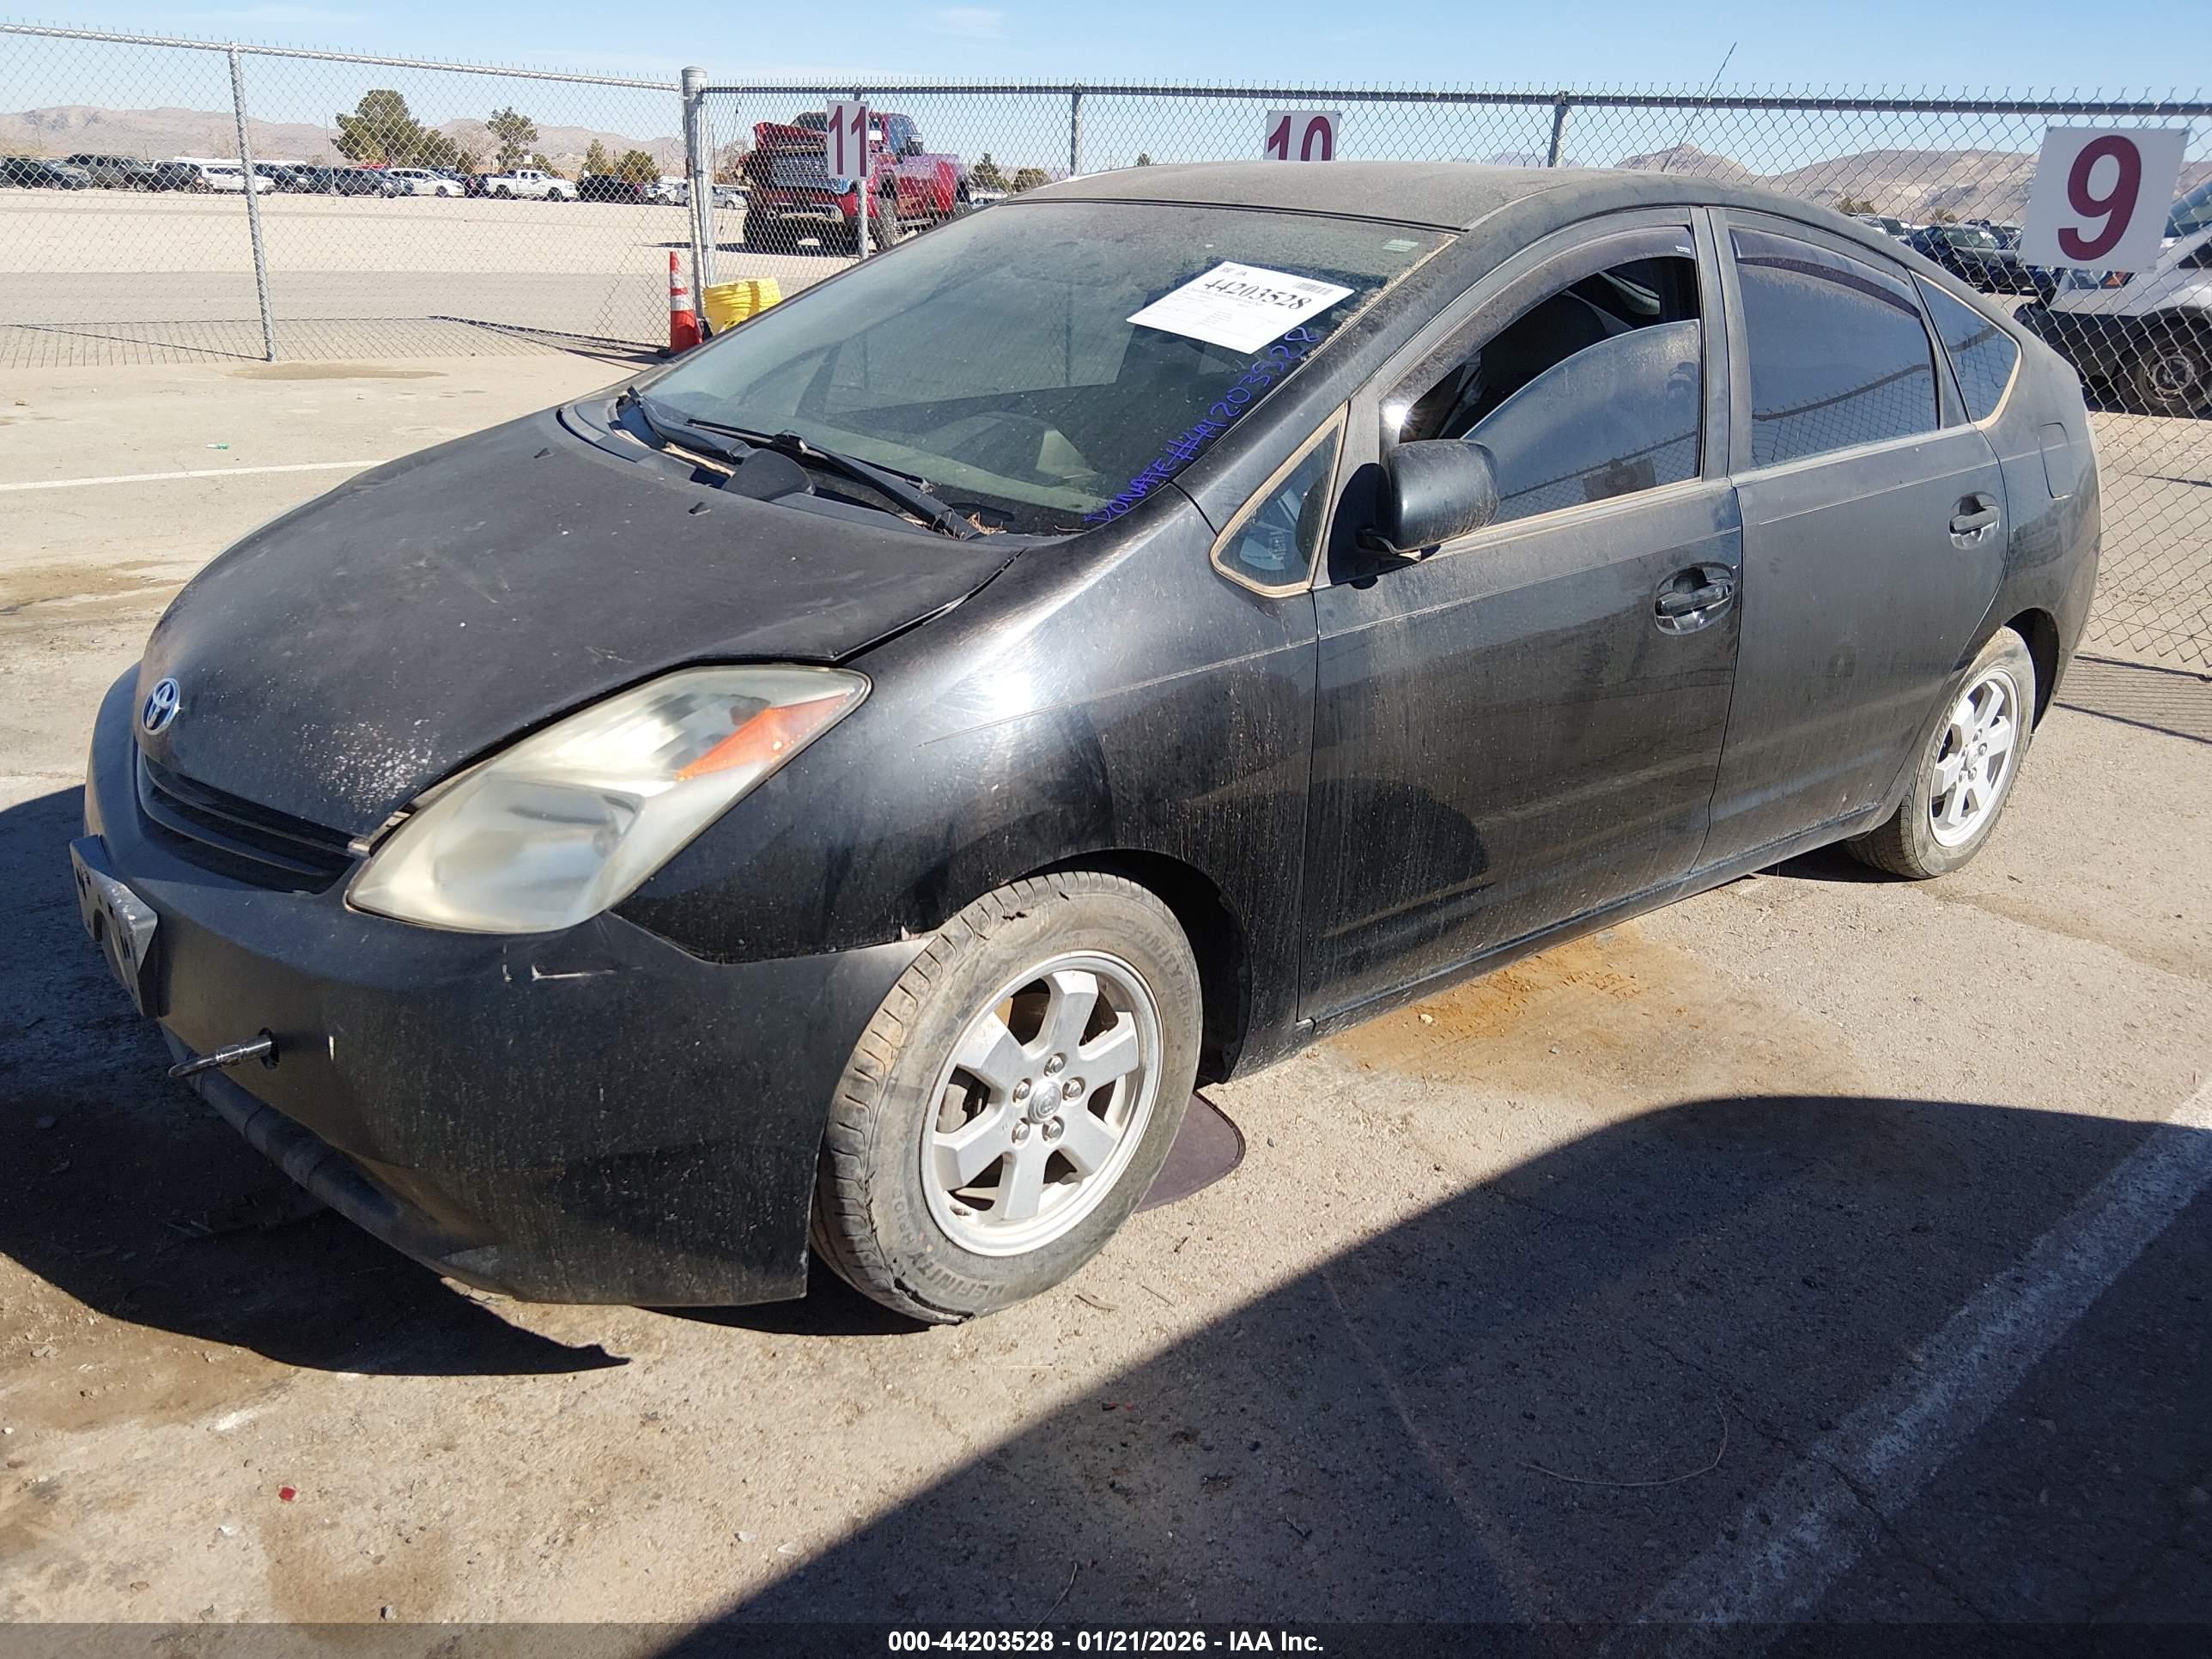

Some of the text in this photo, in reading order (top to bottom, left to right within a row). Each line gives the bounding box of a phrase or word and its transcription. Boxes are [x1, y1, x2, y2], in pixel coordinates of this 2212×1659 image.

[828, 105, 867, 177] 11
[1267, 115, 1333, 161] 10
[2057, 134, 2142, 262] 9
[1204, 278, 1312, 310] 44203528
[1108, 913, 1183, 978] EFINITY
